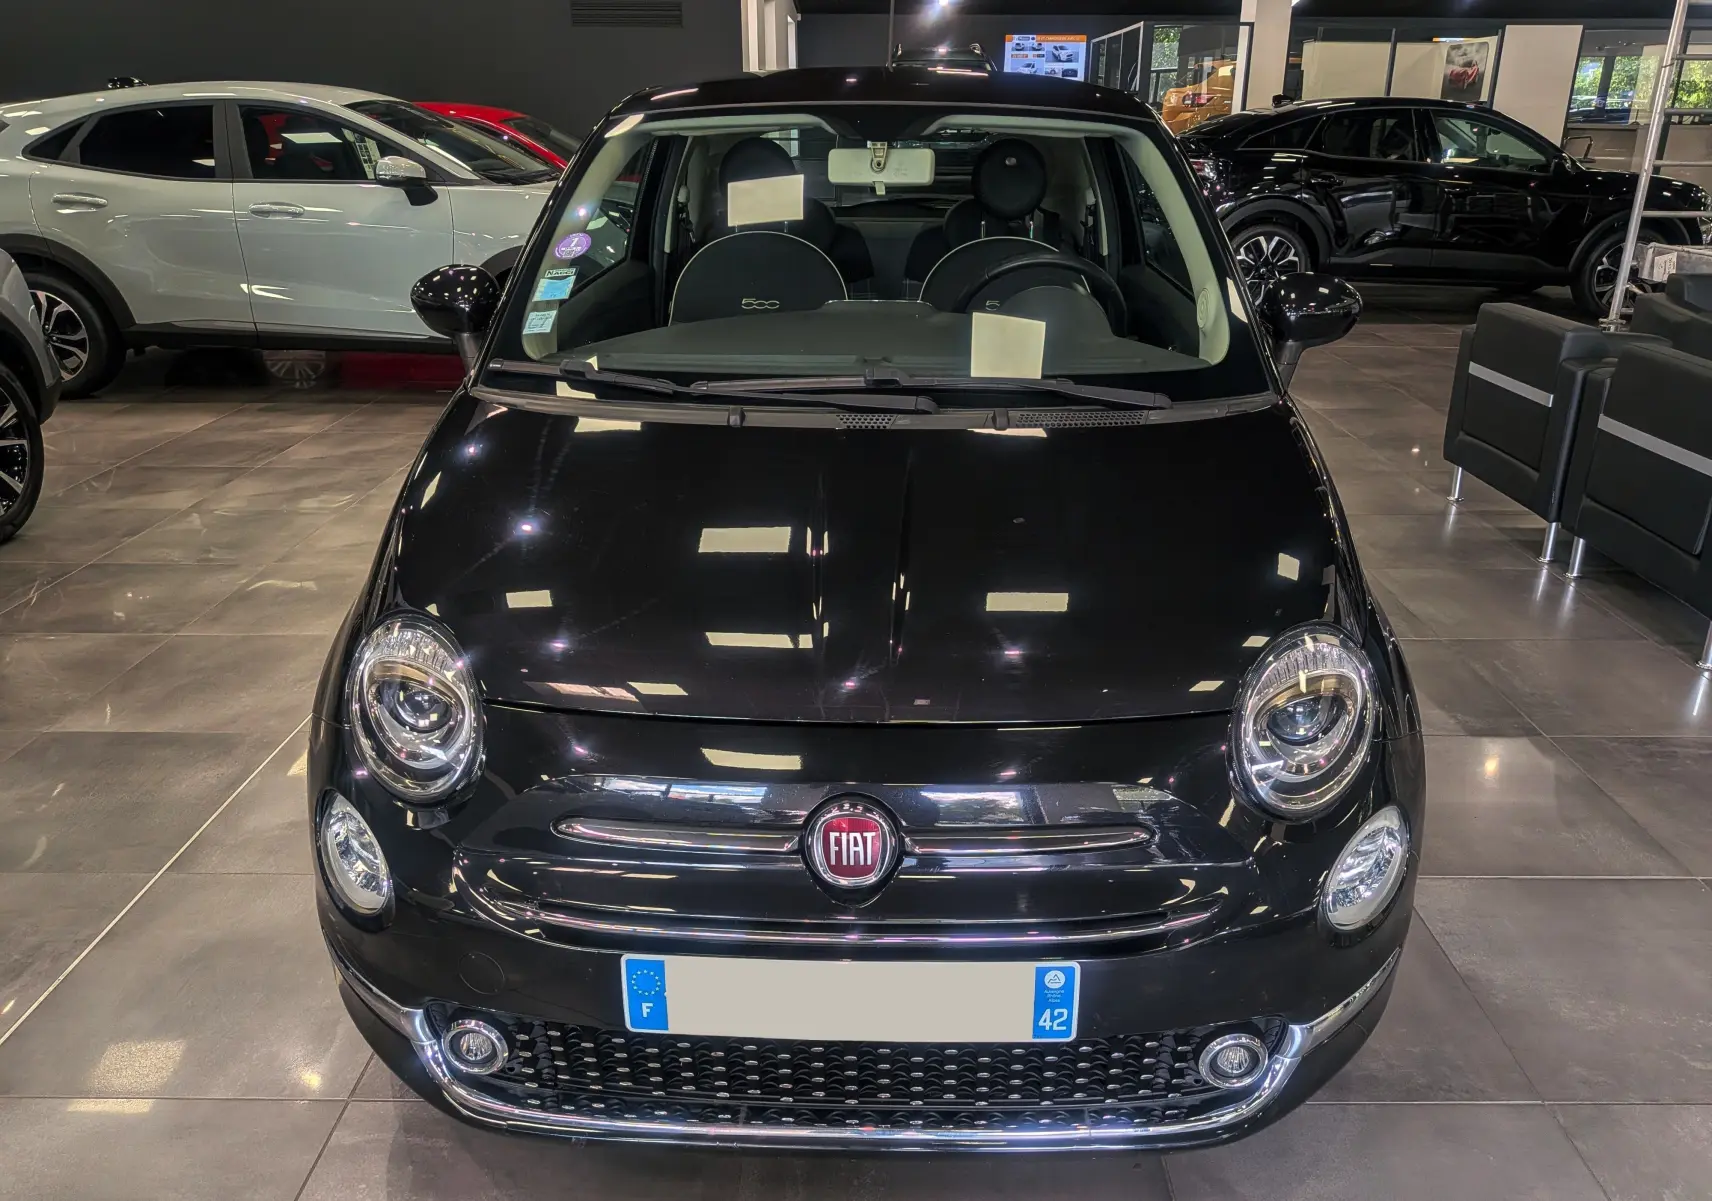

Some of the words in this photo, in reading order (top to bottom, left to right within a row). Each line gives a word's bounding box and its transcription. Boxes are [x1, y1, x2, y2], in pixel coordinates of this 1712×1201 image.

[741, 298, 780, 309] 500
[829, 832, 876, 866] FIAT
[641, 1002, 654, 1018] F
[1038, 1008, 1068, 1031] 42
